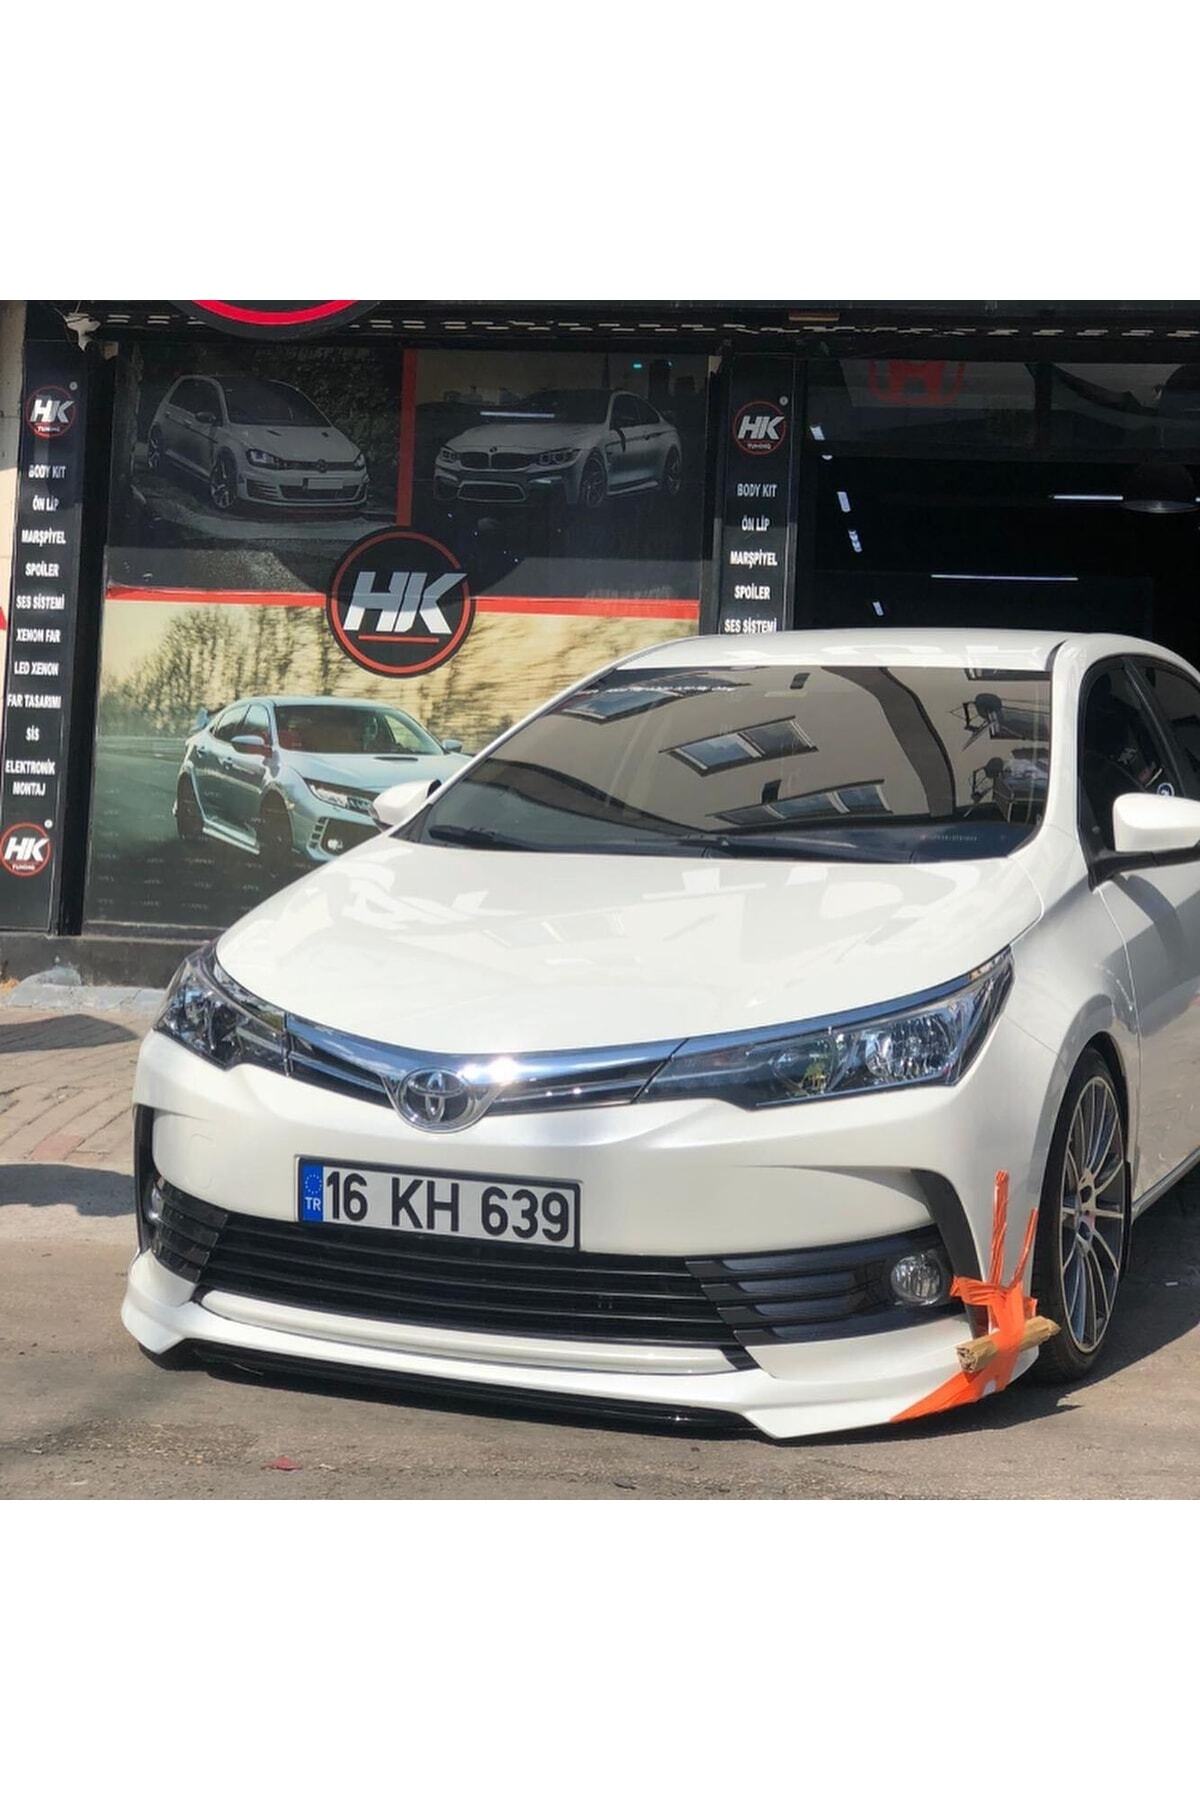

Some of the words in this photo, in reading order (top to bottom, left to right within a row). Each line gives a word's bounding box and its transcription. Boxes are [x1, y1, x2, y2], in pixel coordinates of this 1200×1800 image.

[30, 395, 75, 423] HK
[738, 416, 785, 440] HK
[28, 465, 51, 479] BODY
[52, 466, 66, 479] KIT
[737, 483, 761, 498] BODY
[762, 484, 778, 498] KIT
[32, 495, 45, 511] ÖN
[46, 496, 60, 512] LİP
[741, 514, 754, 531] ÖN
[755, 515, 770, 532] LİP
[21, 527, 67, 547] MARŞPİYEL
[730, 549, 778, 569] MARŞPİYEL
[25, 561, 60, 577] SPOİLER
[734, 583, 770, 600] SPOİLER
[16, 595, 31, 609] SES
[33, 593, 65, 610] SİSTEMİ
[343, 571, 467, 634] HK
[724, 618, 741, 633] SES
[742, 617, 777, 634] SİSTEMİ
[16, 628, 44, 643] XENON
[45, 629, 61, 643] FAR
[14, 661, 30, 675] LED
[31, 662, 59, 676] XENON
[7, 694, 23, 708] FAR
[24, 695, 61, 709] TASARIMI
[25, 725, 40, 741] SİS
[5, 758, 56, 775] ELEKTRONİK
[12, 781, 46, 797] MONTAJ
[4, 837, 49, 861] HK
[305, 1196, 321, 1211] TR
[326, 1171, 368, 1221] 16
[391, 1177, 460, 1232] KH
[481, 1186, 569, 1242] 639
